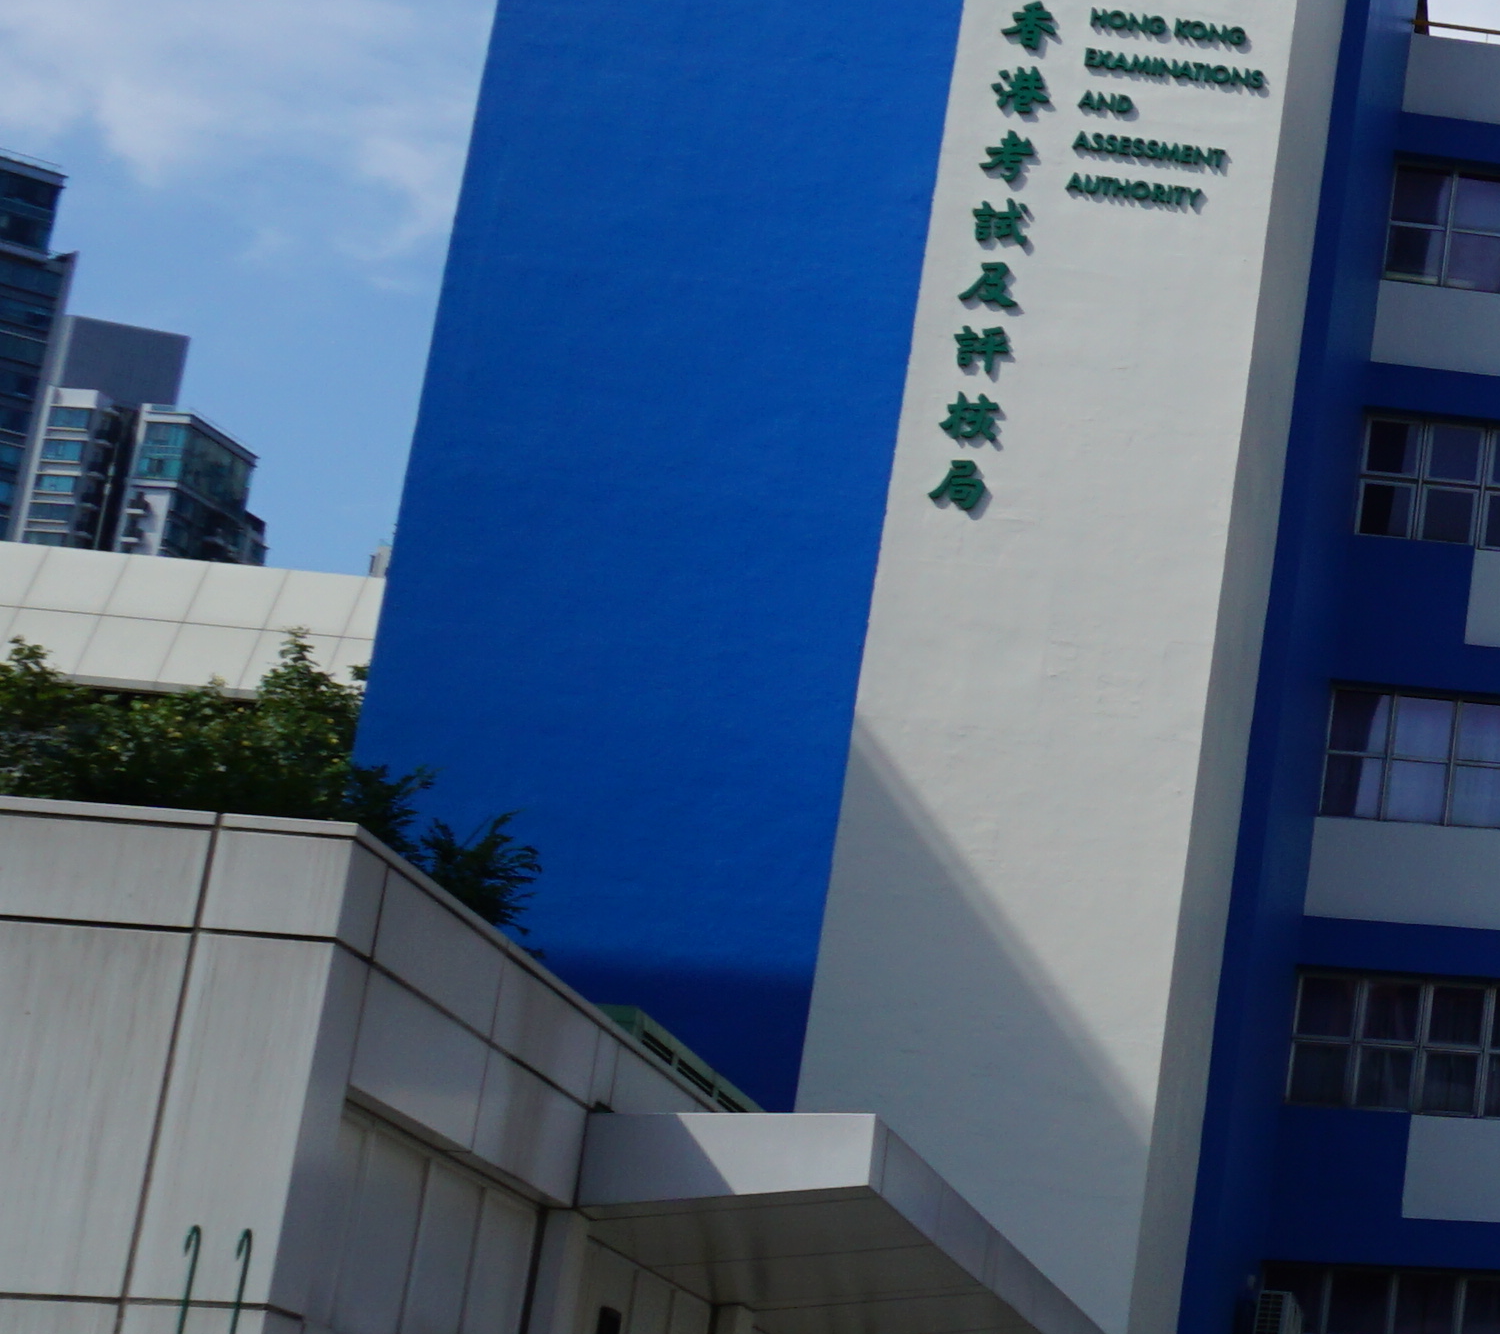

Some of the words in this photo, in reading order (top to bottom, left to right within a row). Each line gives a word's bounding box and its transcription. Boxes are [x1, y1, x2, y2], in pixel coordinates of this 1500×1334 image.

[1089, 7, 1168, 36] HONG
[1173, 18, 1247, 47] KONG
[1084, 47, 1265, 89] EXAMINATIONS
[1077, 90, 1134, 114] AND
[1072, 131, 1226, 168] ASSESSMENT
[1065, 172, 1203, 207] AUTHORITY
[928, 1, 1058, 511] 香港考試及評核局
